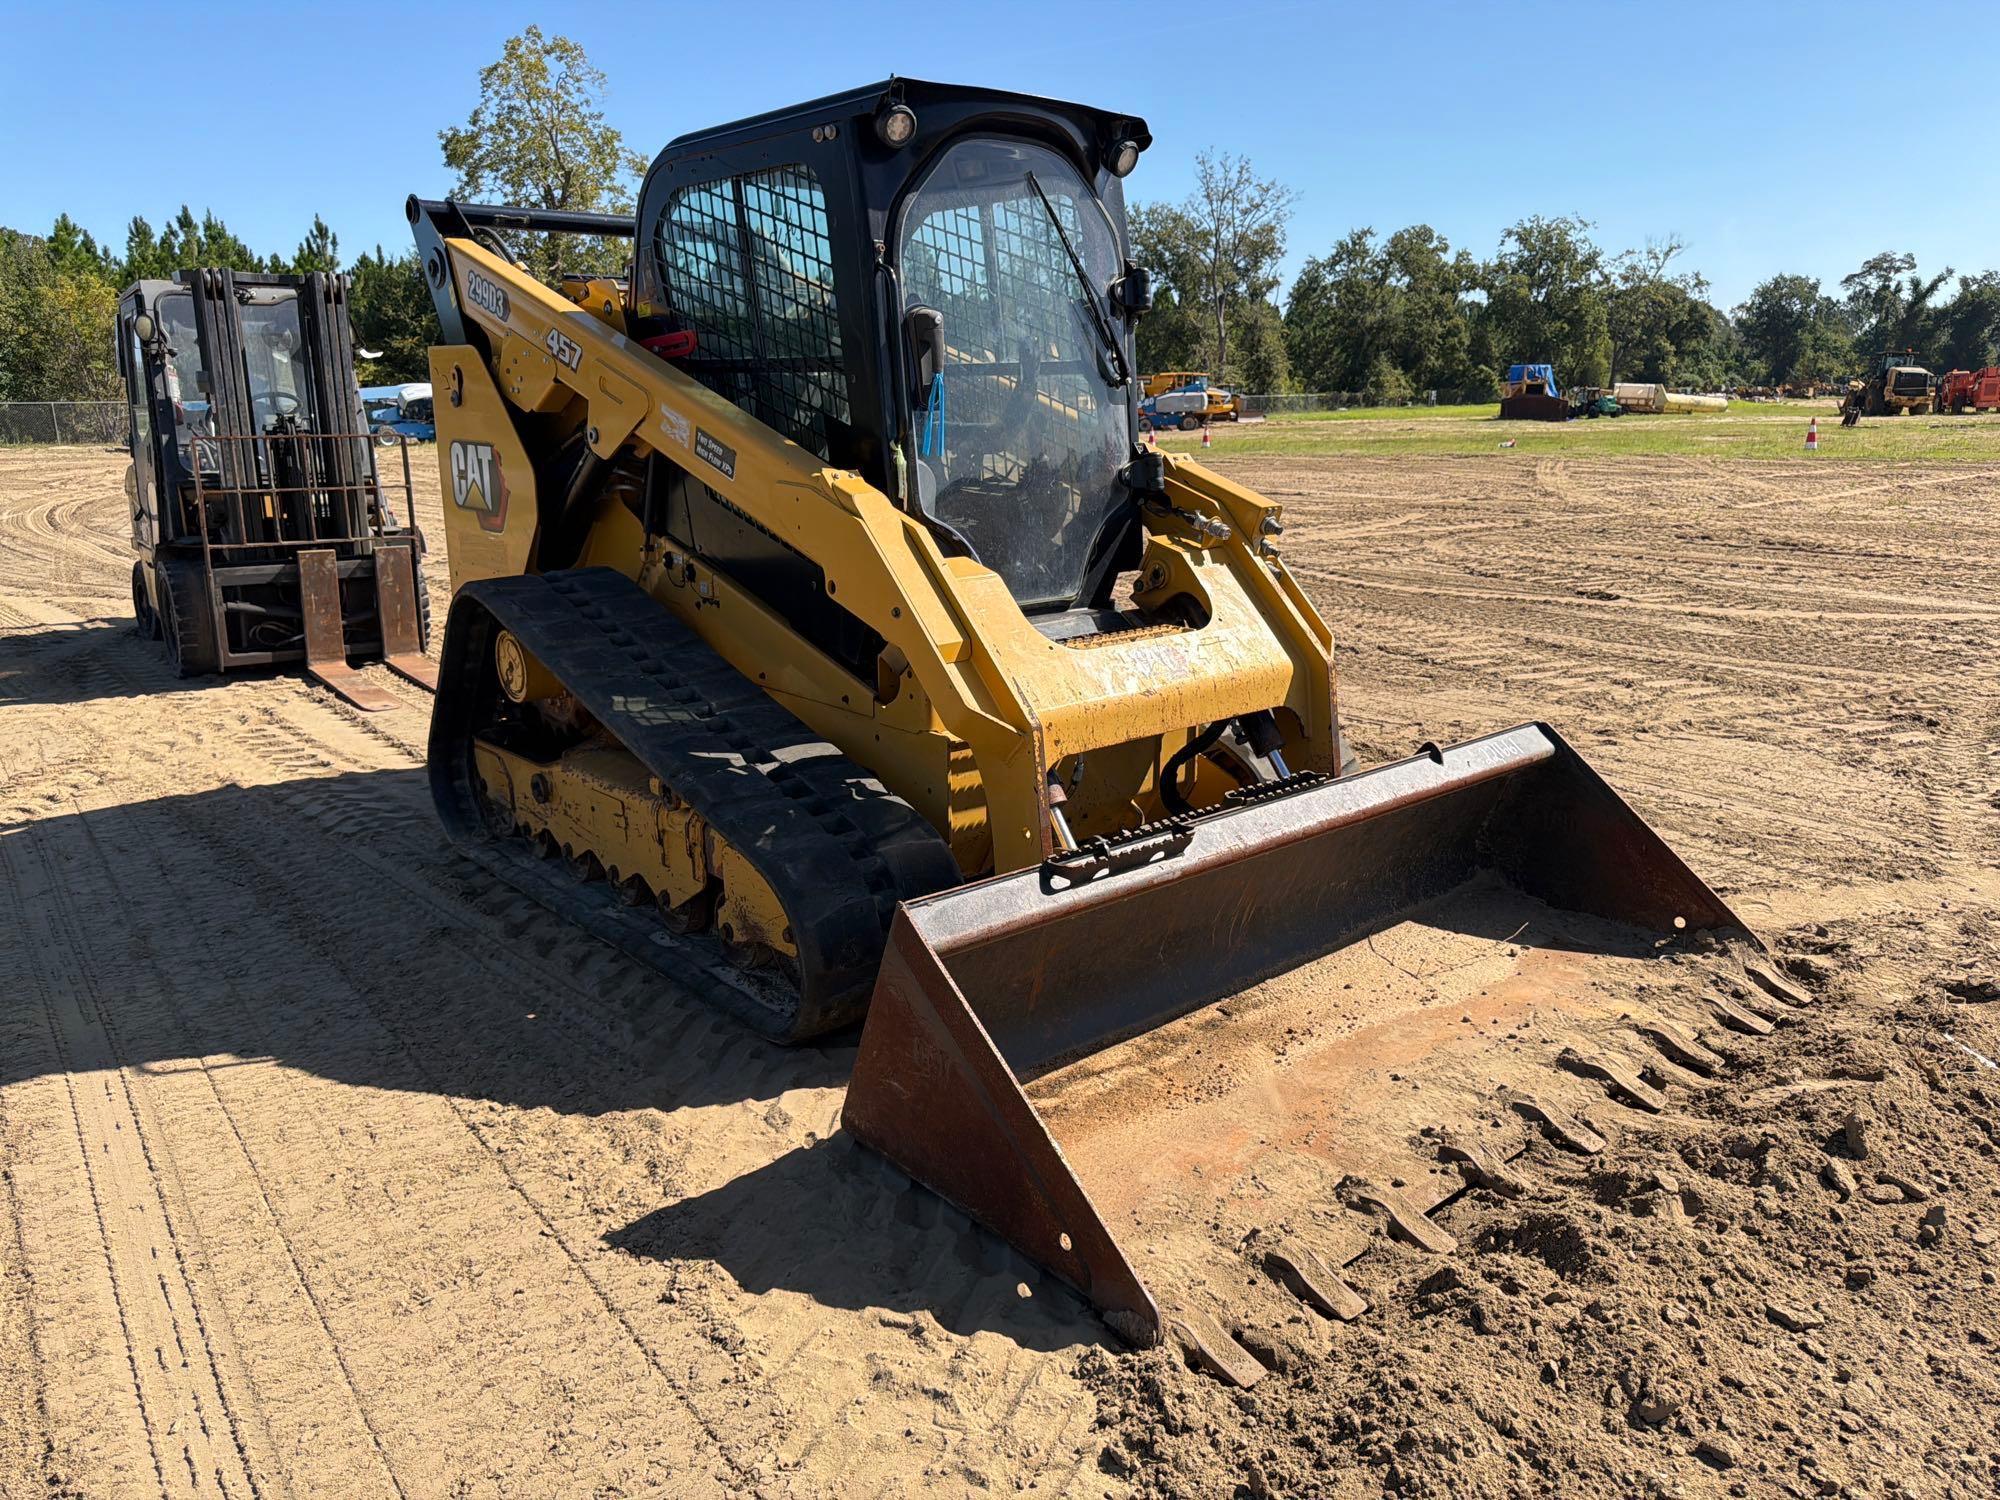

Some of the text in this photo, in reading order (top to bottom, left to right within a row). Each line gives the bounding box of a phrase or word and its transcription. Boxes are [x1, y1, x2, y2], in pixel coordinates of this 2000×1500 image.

[468, 270, 505, 320] 299D3
[546, 327, 583, 374] 457
[450, 441, 493, 512] CAT
